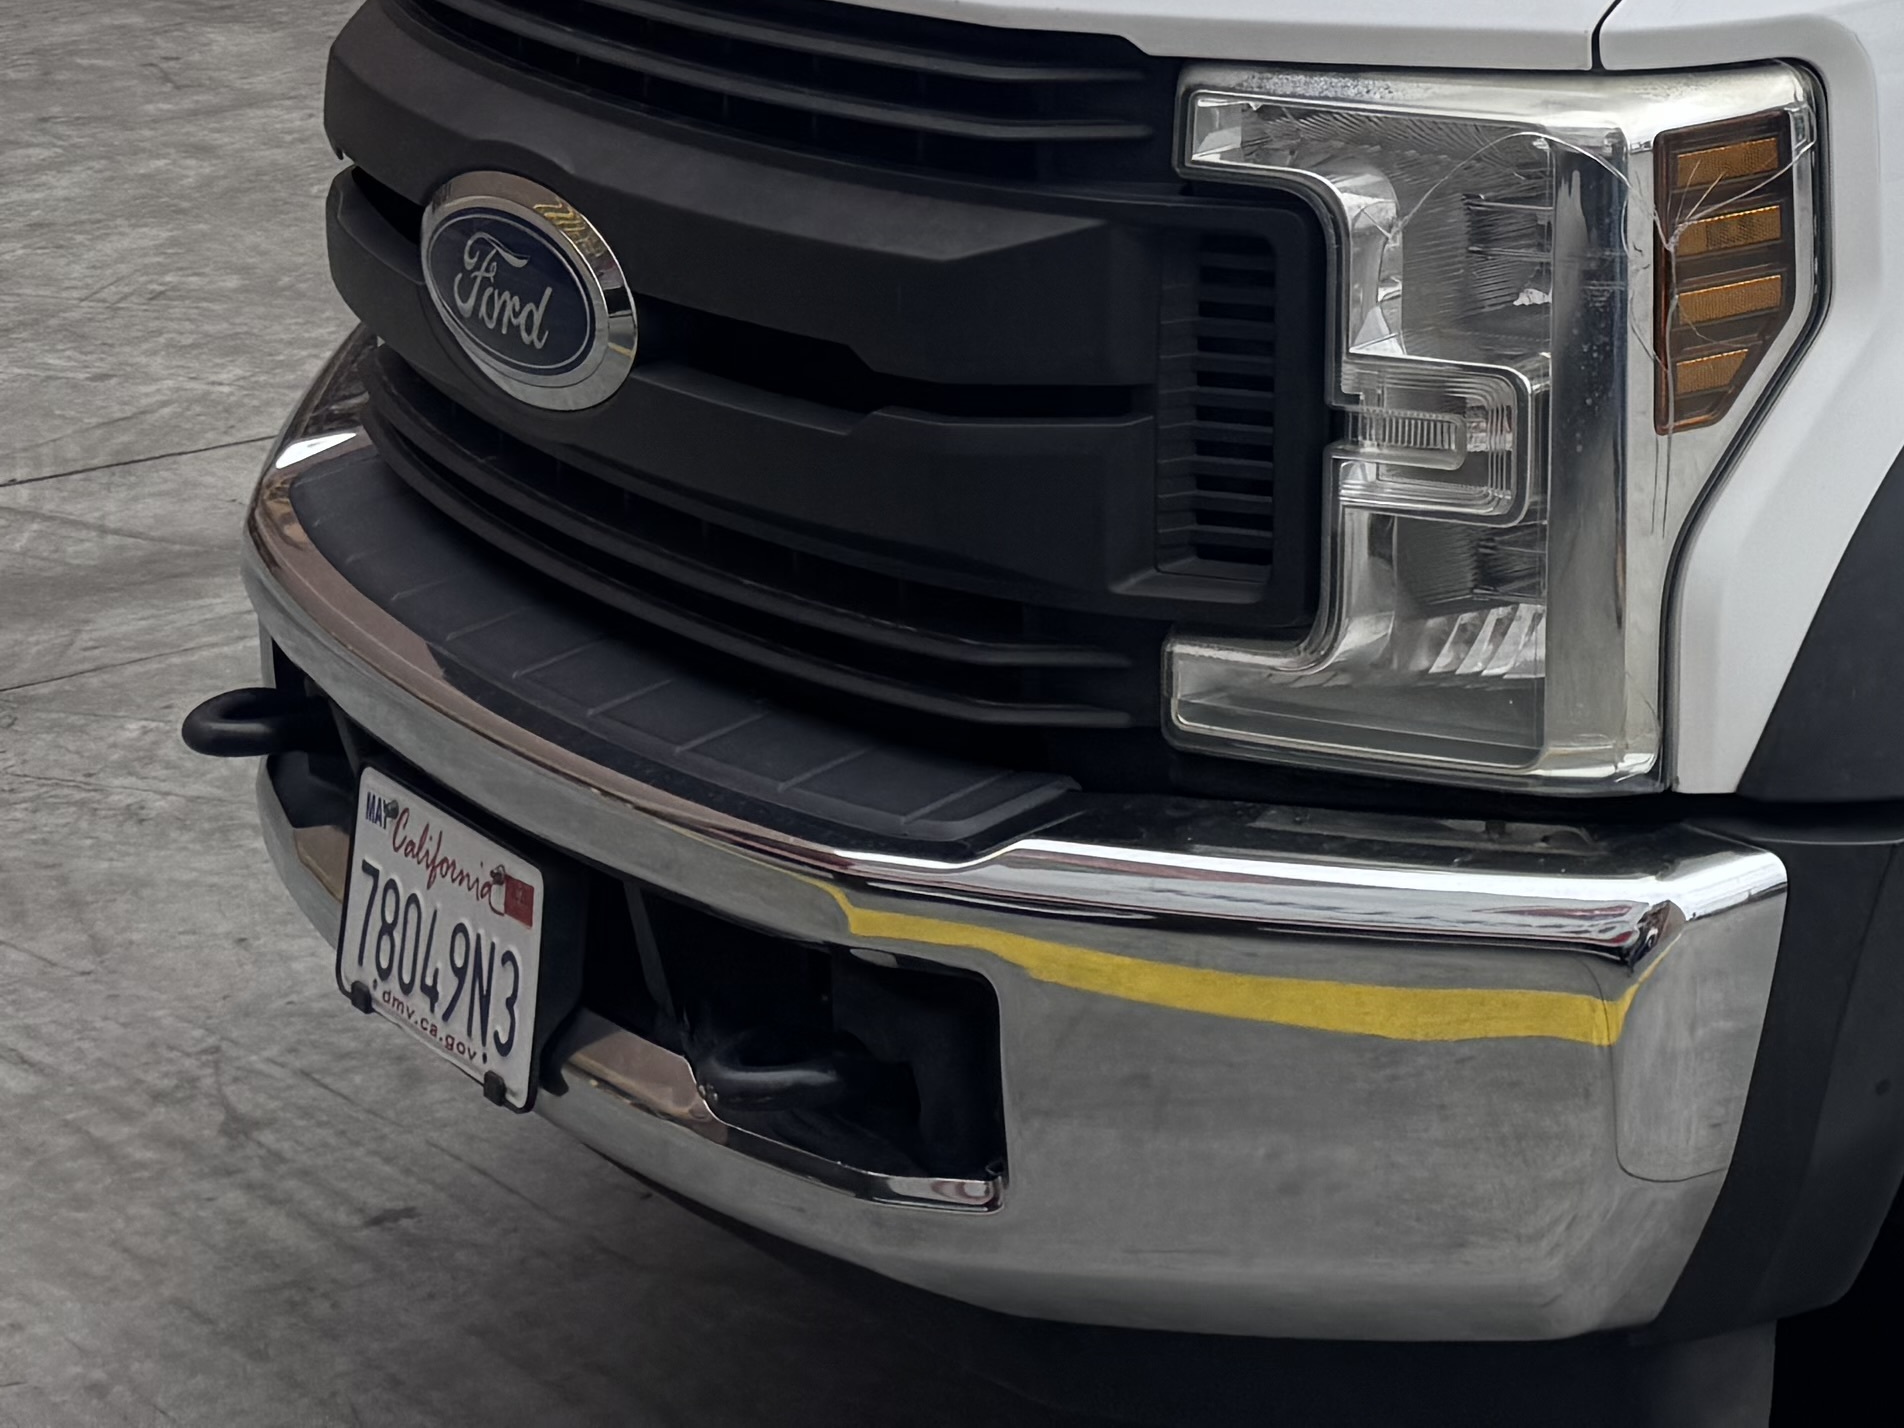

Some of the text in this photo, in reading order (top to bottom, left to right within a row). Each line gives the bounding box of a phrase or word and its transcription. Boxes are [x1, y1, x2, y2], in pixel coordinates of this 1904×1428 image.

[453, 231, 553, 349] Ford
[366, 792, 390, 831] MAY
[391, 806, 505, 917] California
[357, 858, 521, 1058] 78049N3
[382, 990, 478, 1063] dmv.ca.gov
